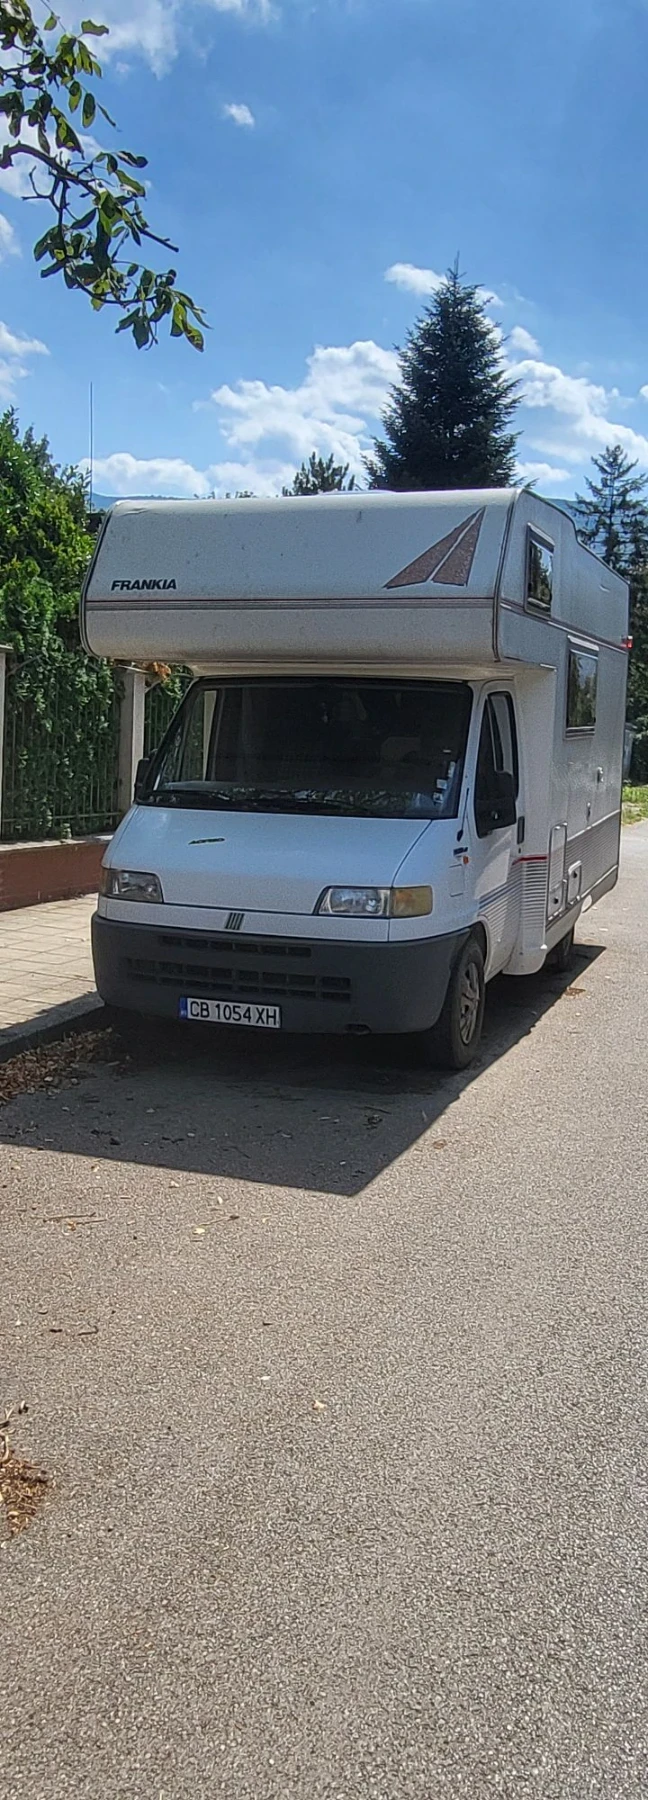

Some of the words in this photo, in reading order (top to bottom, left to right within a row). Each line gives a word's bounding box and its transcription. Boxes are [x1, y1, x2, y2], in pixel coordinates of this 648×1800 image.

[111, 579, 177, 591] FRANKIA
[190, 1001, 210, 1018] CB
[215, 1003, 252, 1023] 1054
[255, 1007, 277, 1026] XH
